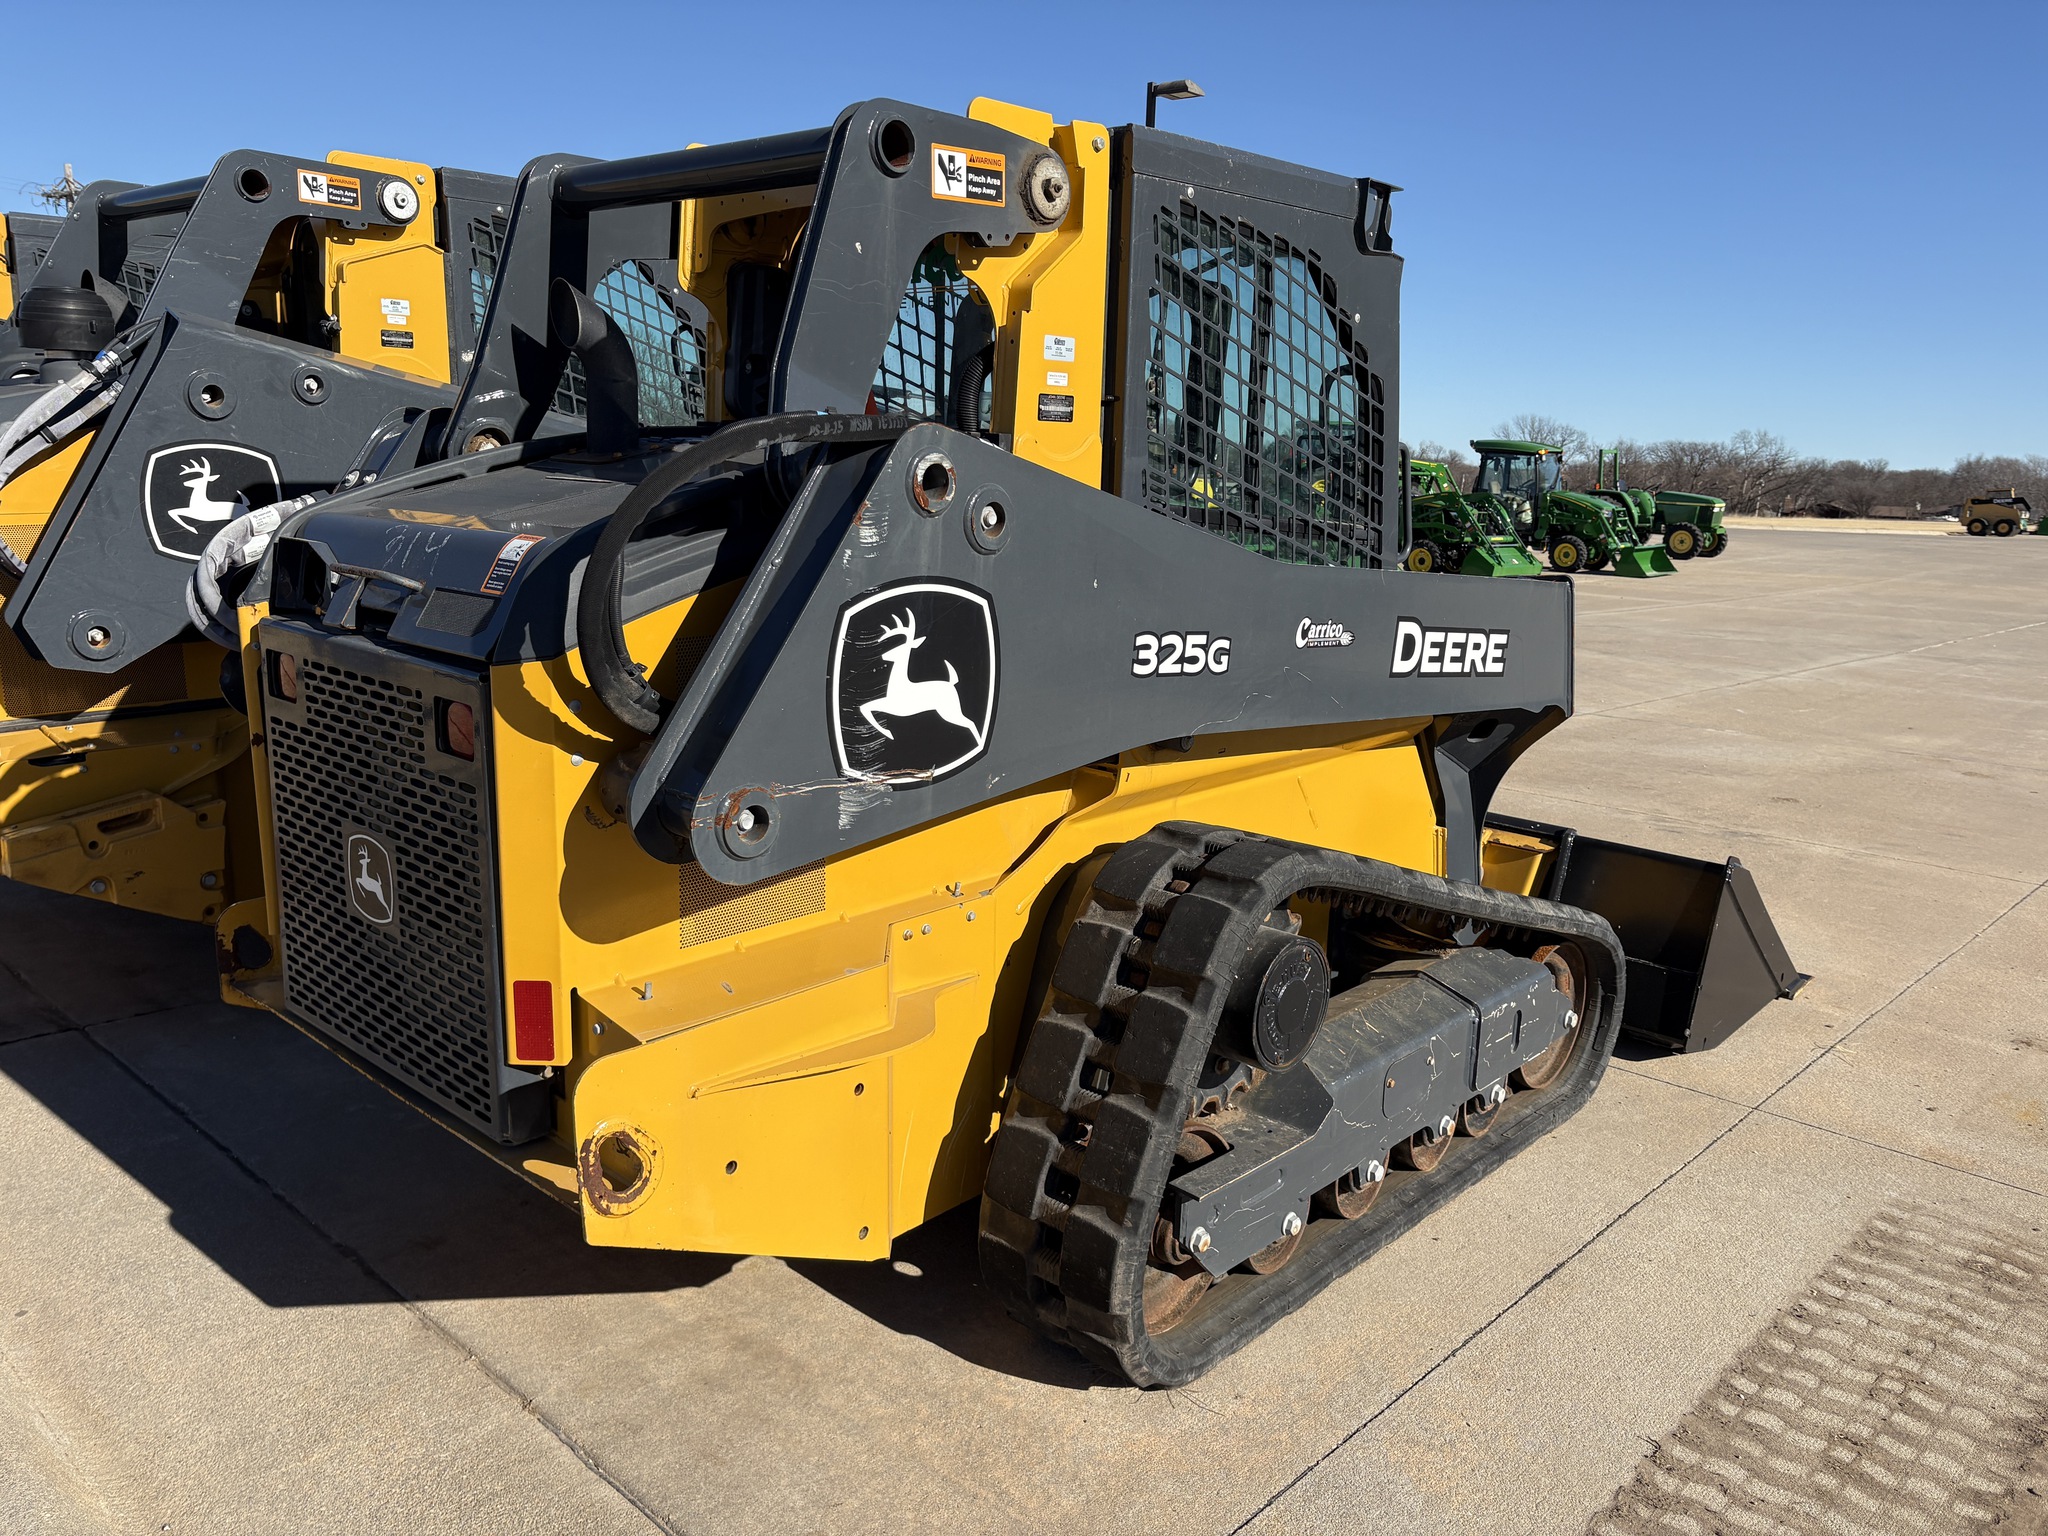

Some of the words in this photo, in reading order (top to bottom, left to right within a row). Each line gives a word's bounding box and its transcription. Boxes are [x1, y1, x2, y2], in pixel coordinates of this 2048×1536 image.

[975, 156, 1002, 166] WARNING
[968, 173, 986, 184] Pinch
[986, 175, 1001, 186] Area
[328, 187, 344, 195] Pinch
[968, 184, 982, 194] Keep
[982, 186, 997, 197] Away
[1296, 617, 1343, 648] Carrico
[1391, 620, 1508, 675] DEERE
[1132, 633, 1231, 676] 325G
